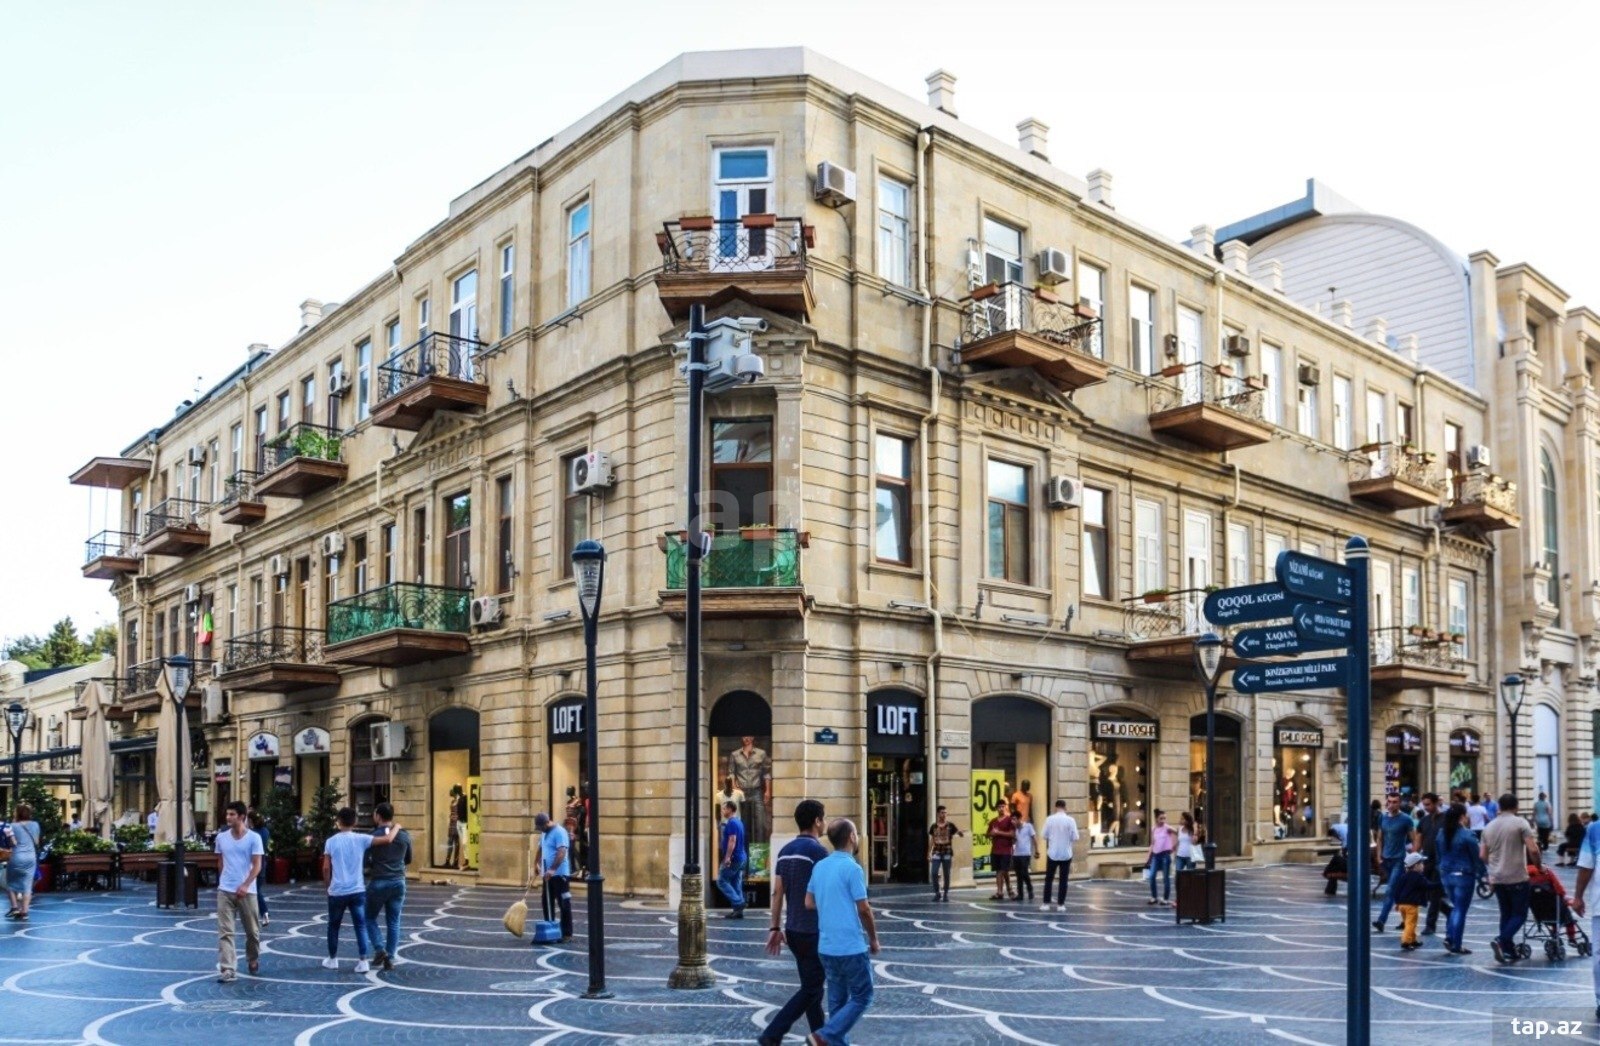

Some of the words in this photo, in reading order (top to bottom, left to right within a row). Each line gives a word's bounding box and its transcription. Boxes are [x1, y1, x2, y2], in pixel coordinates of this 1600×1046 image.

[1217, 594, 1255, 610] QOQOL
[1321, 663, 1337, 673] PARK
[1284, 676, 1305, 684] National
[1306, 675, 1317, 683] Park
[469, 784, 481, 813] 5
[973, 779, 1001, 812] 50
